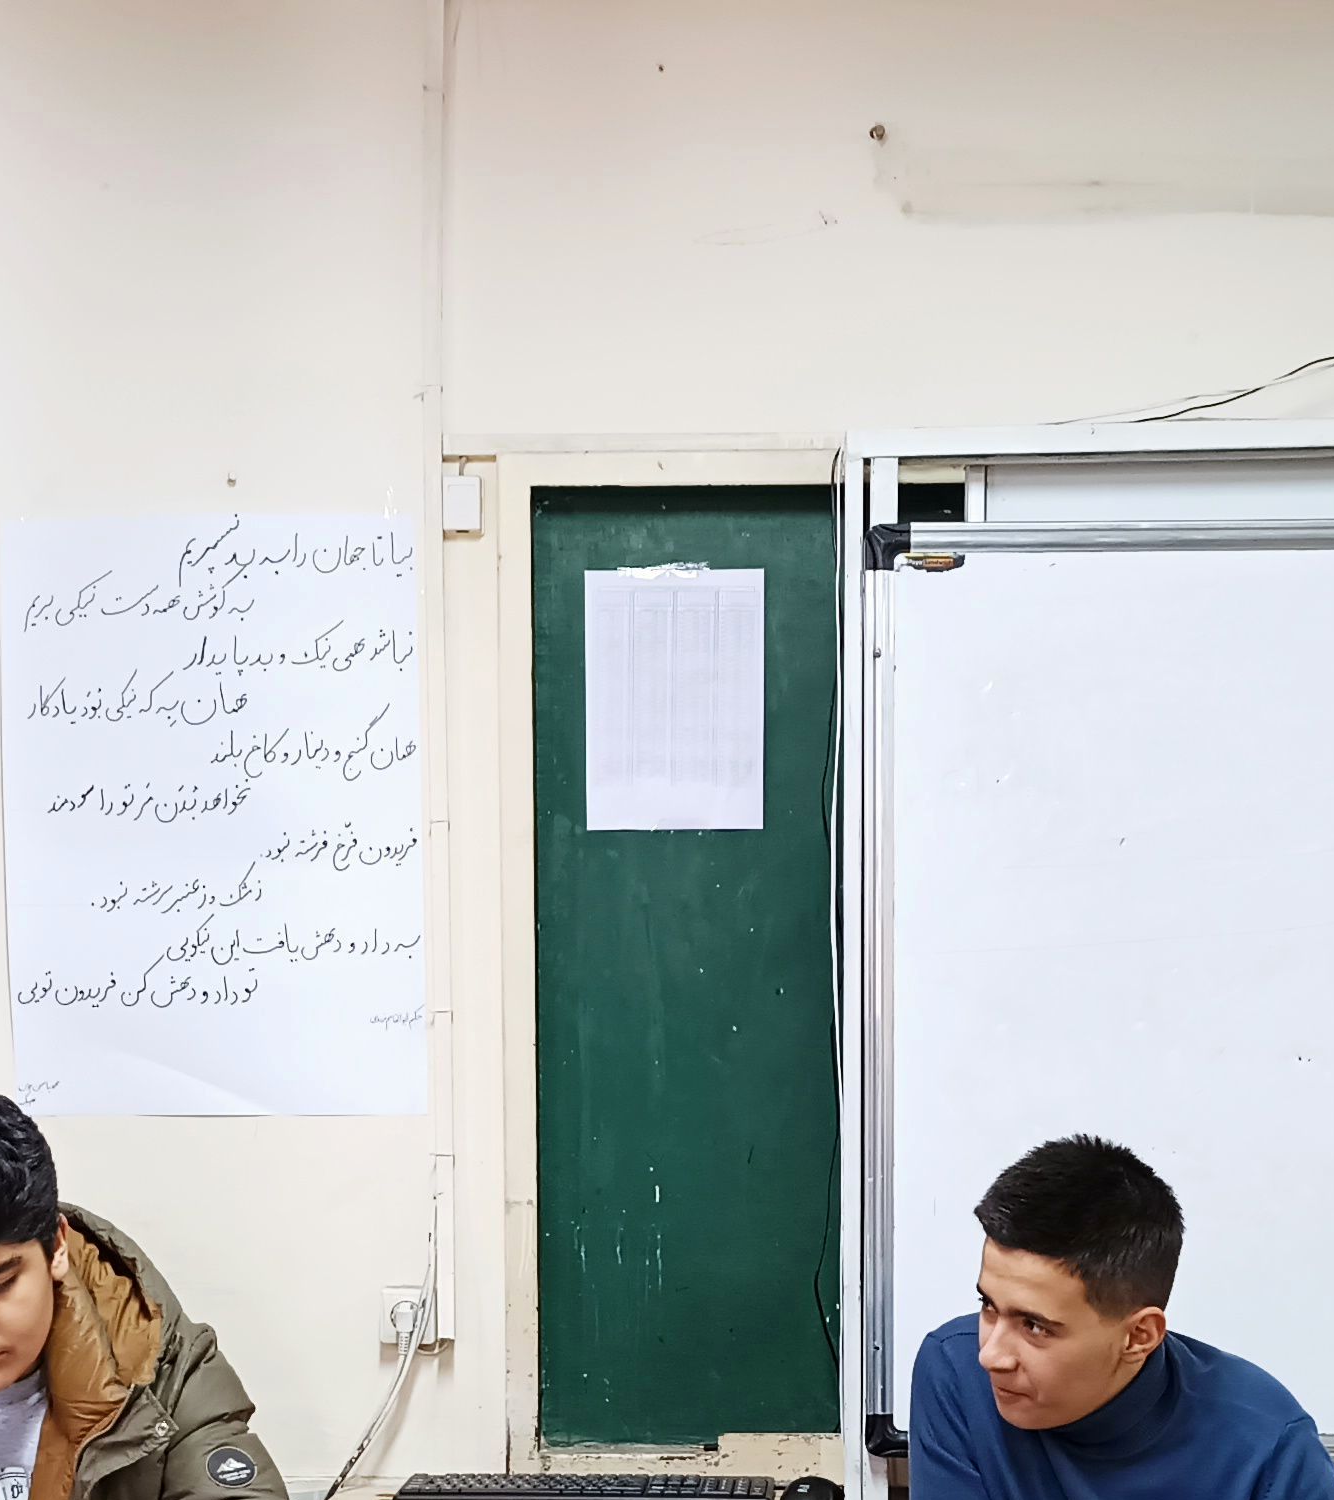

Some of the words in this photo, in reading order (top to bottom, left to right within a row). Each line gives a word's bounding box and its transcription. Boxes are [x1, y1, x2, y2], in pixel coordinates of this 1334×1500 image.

[179, 514, 239, 587] نسپریم
[224, 549, 255, 579] بد
[259, 549, 290, 575] به
[292, 533, 306, 568] را
[313, 536, 366, 573] جهان
[372, 536, 384, 566] تا
[391, 532, 413, 577] بیا
[55, 570, 112, 626] نیکی
[101, 585, 159, 616] دست
[153, 595, 180, 615] همه
[183, 566, 247, 620] کوشش
[228, 599, 254, 621] به
[24, 595, 54, 632] بریم
[183, 635, 248, 676] پایدار
[279, 653, 285, 664] و
[291, 620, 344, 669] نیک
[332, 638, 365, 672] همی
[370, 629, 413, 671] نباشد
[249, 653, 273, 672] بد
[105, 669, 137, 722] نیکی
[139, 671, 174, 713] که
[181, 682, 247, 725] همان
[211, 730, 242, 767] بلند
[244, 728, 289, 778] کاخ
[281, 752, 289, 763] و
[291, 731, 329, 769] دینار
[333, 750, 341, 762] و
[343, 703, 390, 781] گنج
[371, 737, 416, 770] همان
[100, 789, 113, 815] را
[117, 784, 134, 816] تو
[295, 829, 328, 862] فرشته
[359, 828, 417, 866] فریدون
[161, 879, 199, 914] عنبر
[167, 913, 214, 962] نیکویی
[211, 929, 239, 965] این
[243, 923, 298, 963] یافت
[301, 928, 341, 960] دهش
[348, 942, 355, 953] و
[394, 935, 421, 959] به
[18, 971, 52, 1004] تویی
[55, 972, 116, 1008] فریدون
[121, 954, 164, 1007] کن
[151, 976, 196, 1008] دهش
[200, 991, 208, 1004] و
[214, 976, 238, 1005] داد
[242, 968, 258, 1003] تو
